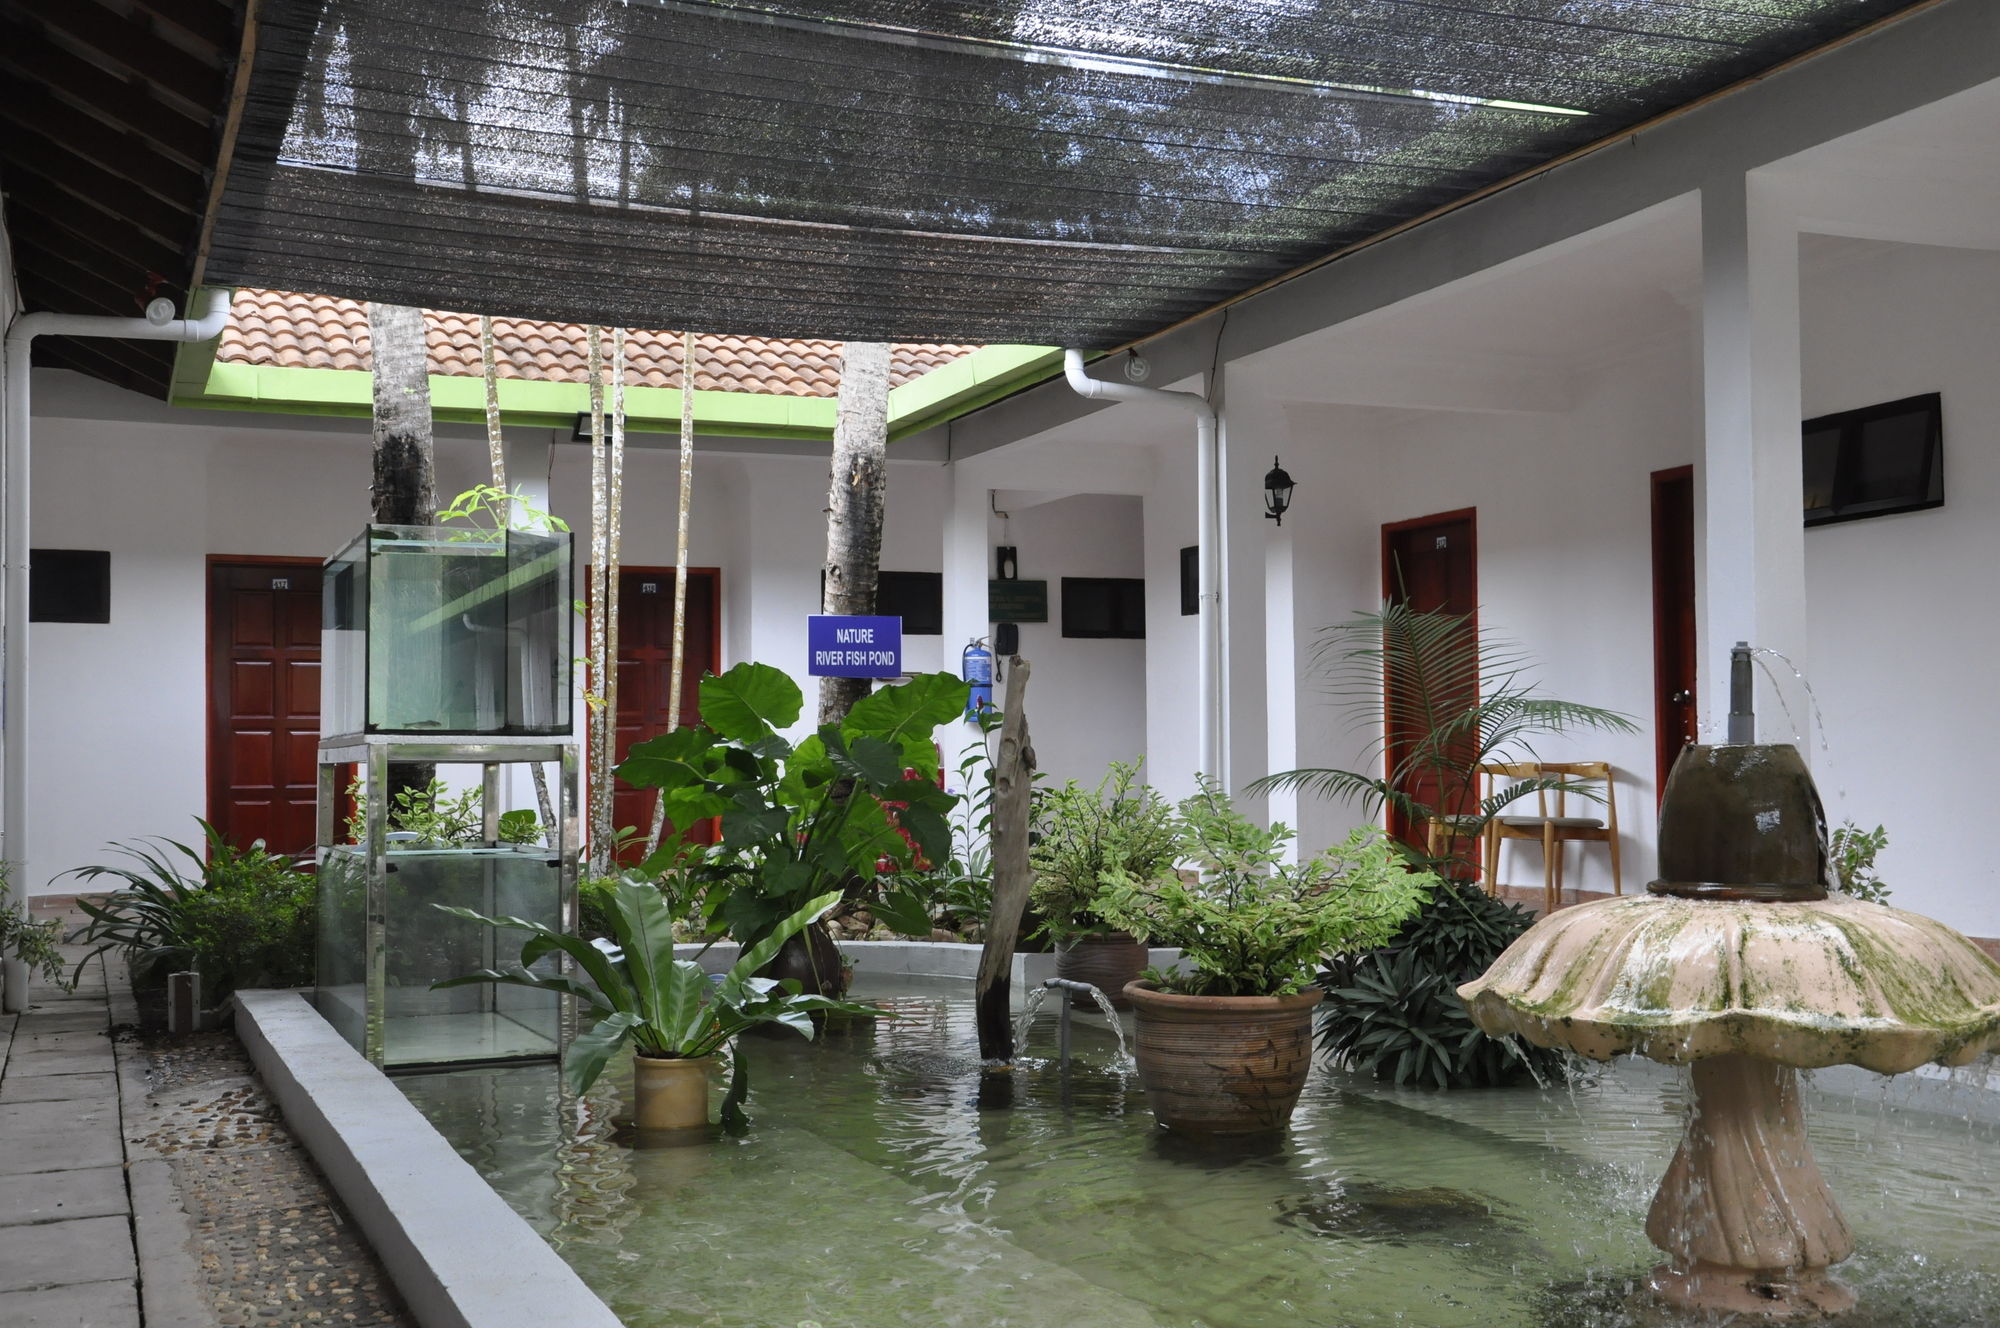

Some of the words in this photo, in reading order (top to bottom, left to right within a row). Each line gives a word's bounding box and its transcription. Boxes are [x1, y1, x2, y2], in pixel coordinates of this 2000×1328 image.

[836, 628, 874, 644] NATURE
[815, 650, 844, 666] RIVER
[846, 650, 867, 666] FISH
[868, 650, 895, 666] POND
